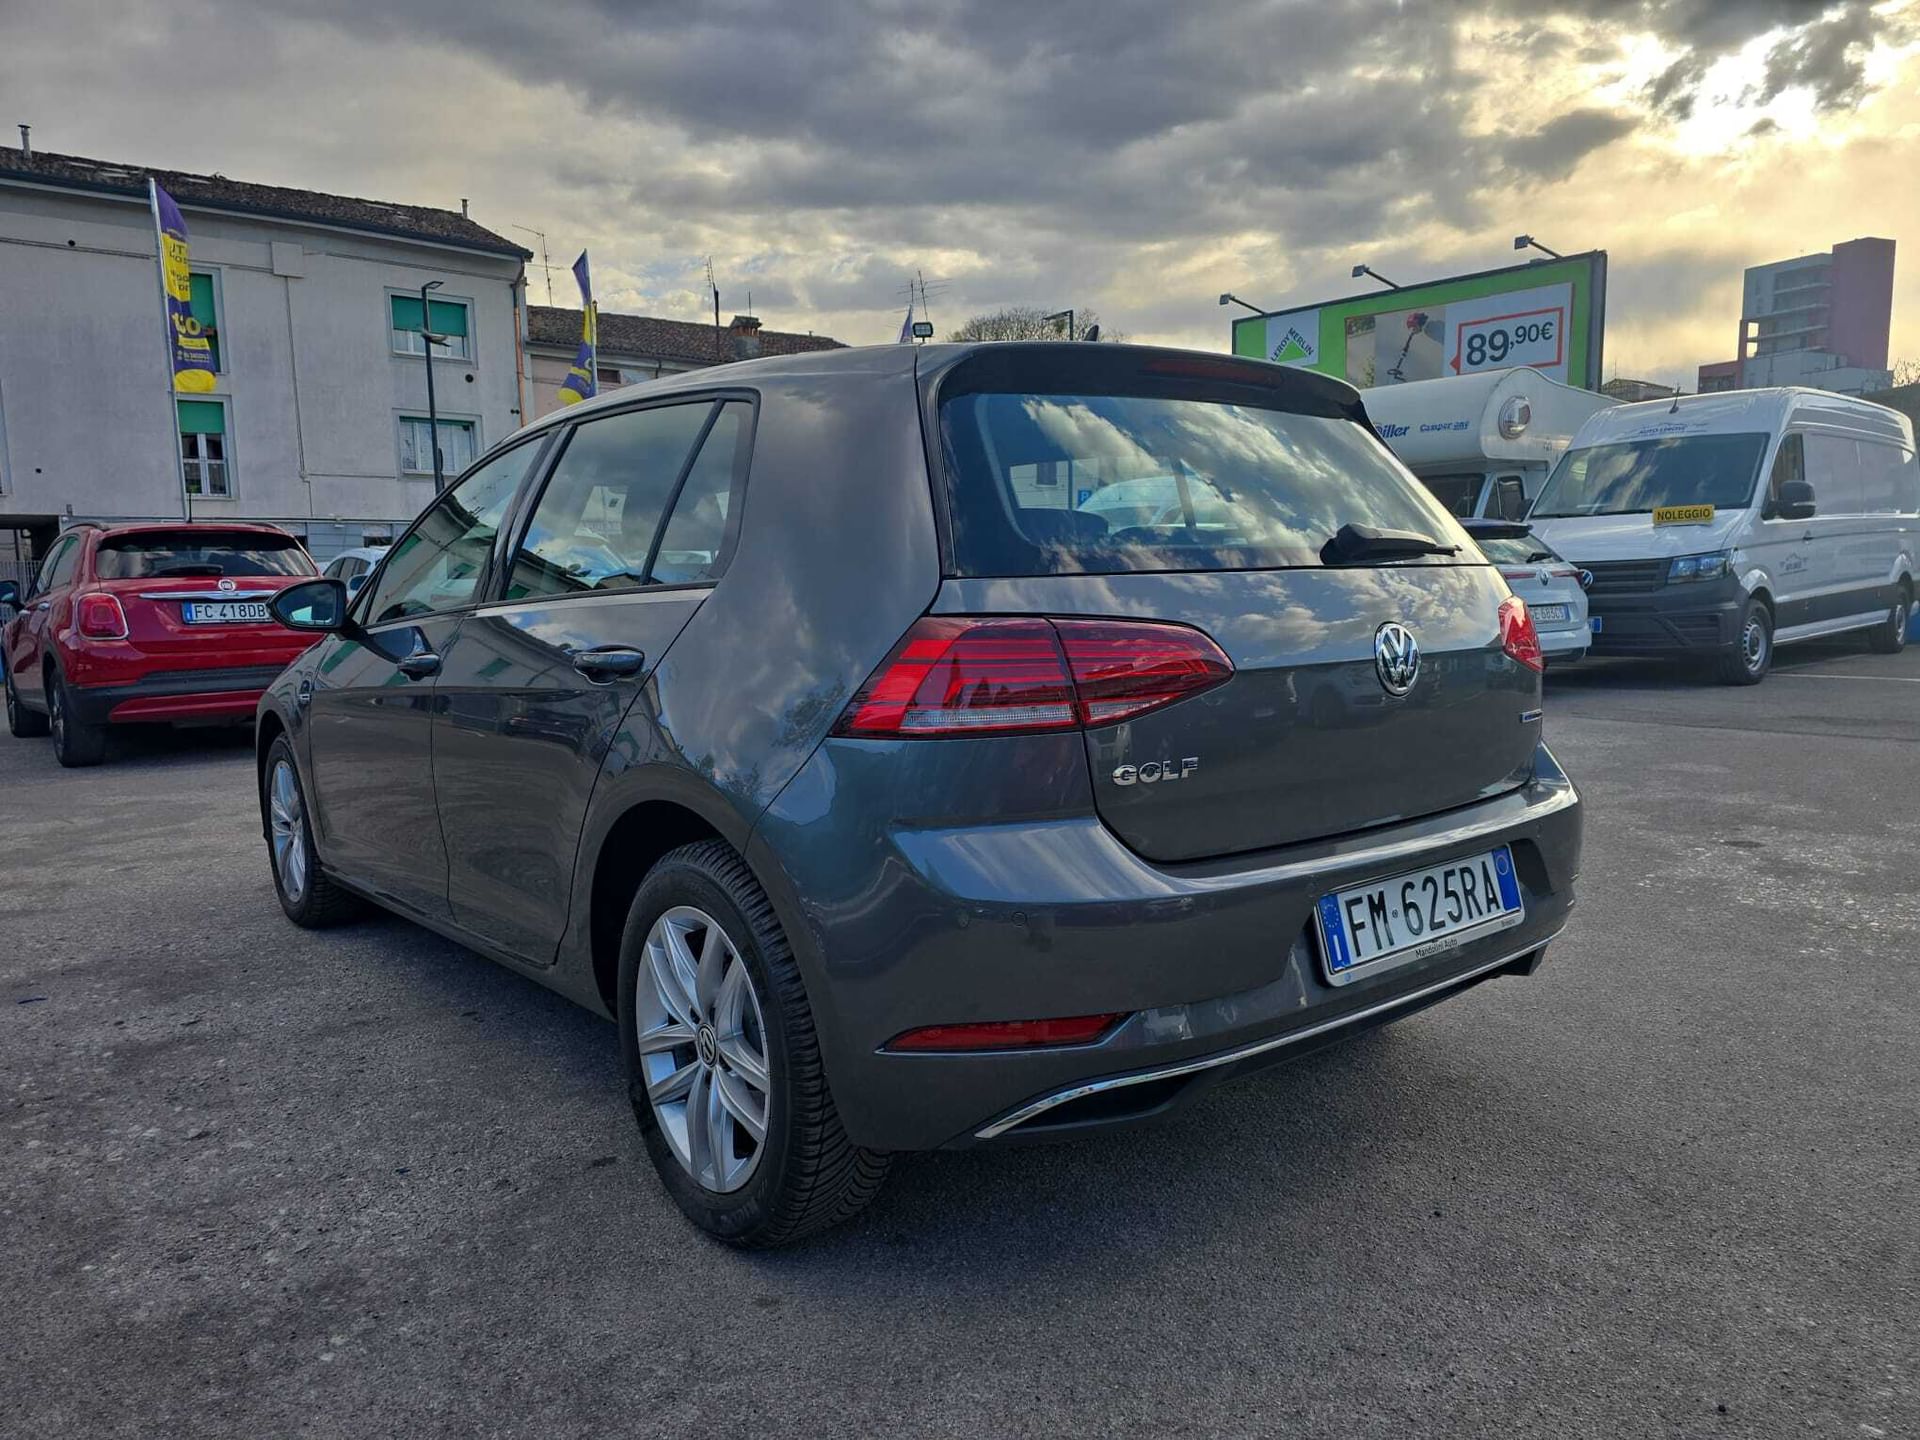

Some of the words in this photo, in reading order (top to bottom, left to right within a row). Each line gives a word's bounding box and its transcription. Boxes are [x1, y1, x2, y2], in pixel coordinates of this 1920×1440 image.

[1271, 335, 1290, 361] LEROY
[1288, 327, 1314, 355] MERLIN
[1466, 321, 1554, 366] 89,90€
[1657, 508, 1711, 521] NOLEGGIO
[194, 604, 213, 618] FC
[219, 603, 266, 618] 418DB
[1112, 757, 1199, 785] GOLF
